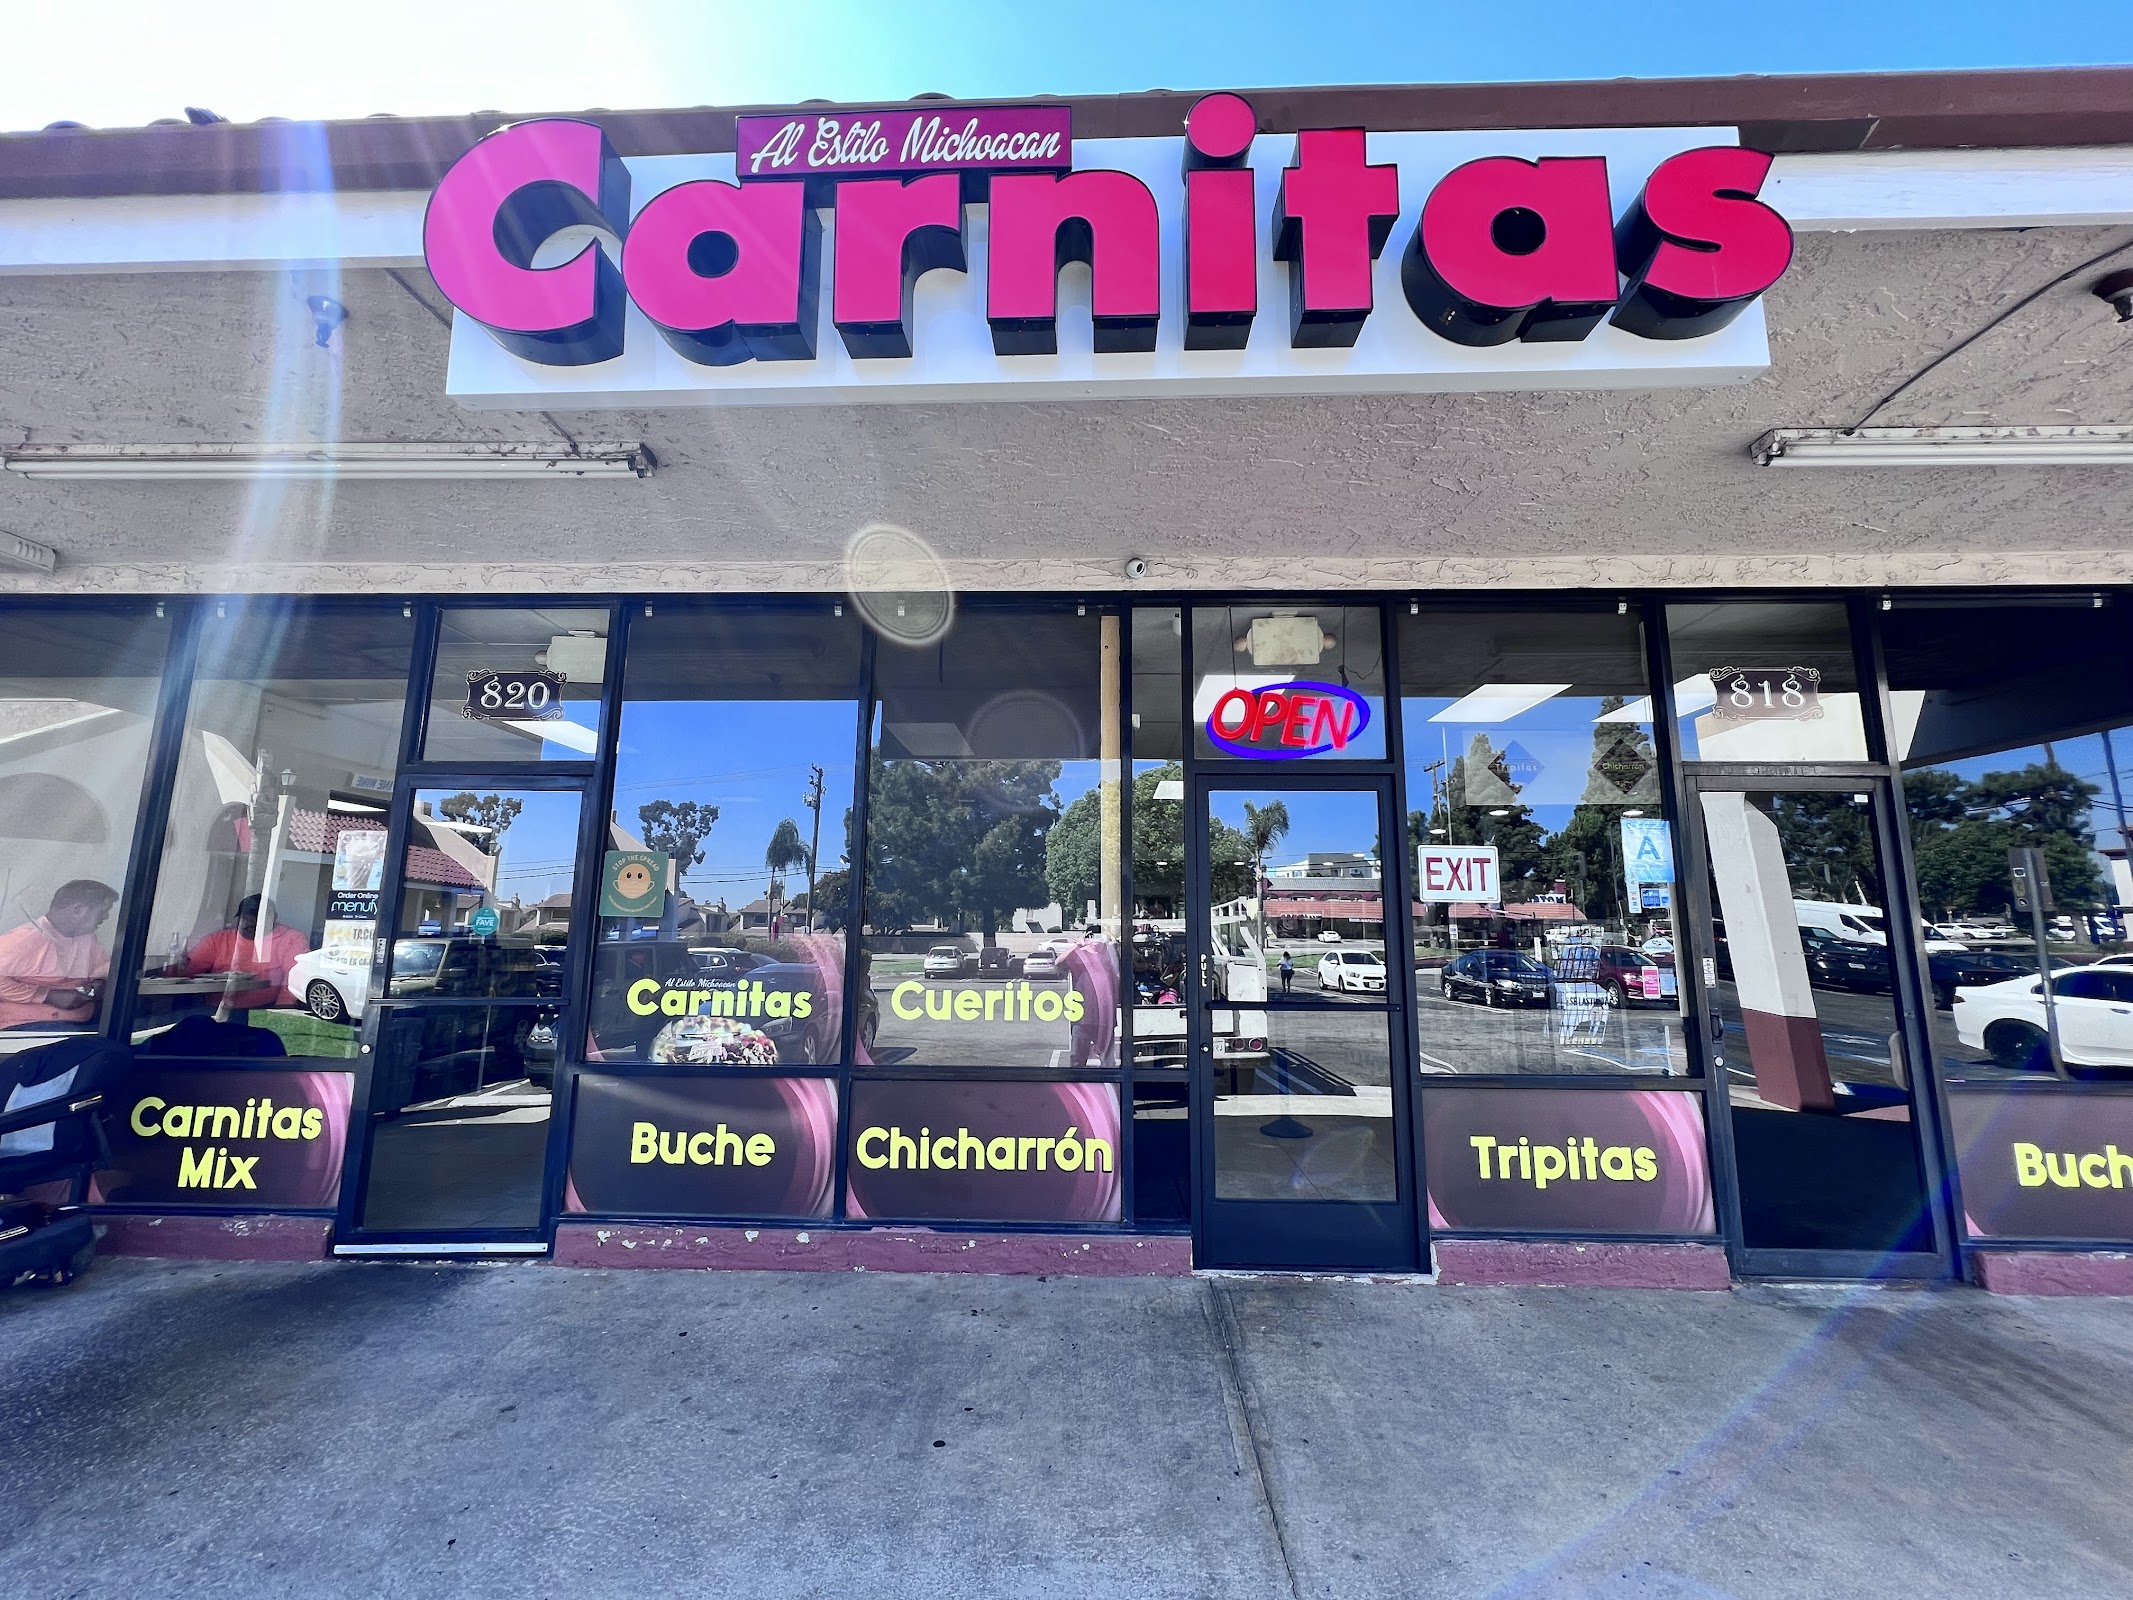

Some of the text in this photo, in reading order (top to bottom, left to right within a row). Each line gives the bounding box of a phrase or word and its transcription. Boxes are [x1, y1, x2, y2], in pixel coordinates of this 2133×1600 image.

[750, 115, 1061, 174] Al Estilo Michoacan
[423, 92, 1793, 333] Carnitas
[480, 675, 551, 710] 820
[1730, 673, 1807, 709] 818
[1211, 687, 1356, 751] OPEN
[612, 857, 626, 871] STOP
[640, 854, 660, 872] SPREAD
[1637, 835, 1661, 860] A
[1426, 857, 1491, 891] EXIT
[664, 977, 737, 989] Al Estilo Michoacan
[1200, 953, 1208, 987] PULL
[627, 978, 812, 1018] Carnitas
[892, 981, 1084, 1021] Cueritos
[131, 1097, 322, 1139] Carnitas
[631, 1122, 775, 1166] Buche
[857, 1127, 1112, 1171] Chicharrón
[1471, 1136, 1658, 1189] Tripitas
[178, 1147, 257, 1189] Mix
[2015, 1143, 2133, 1189] Buch
